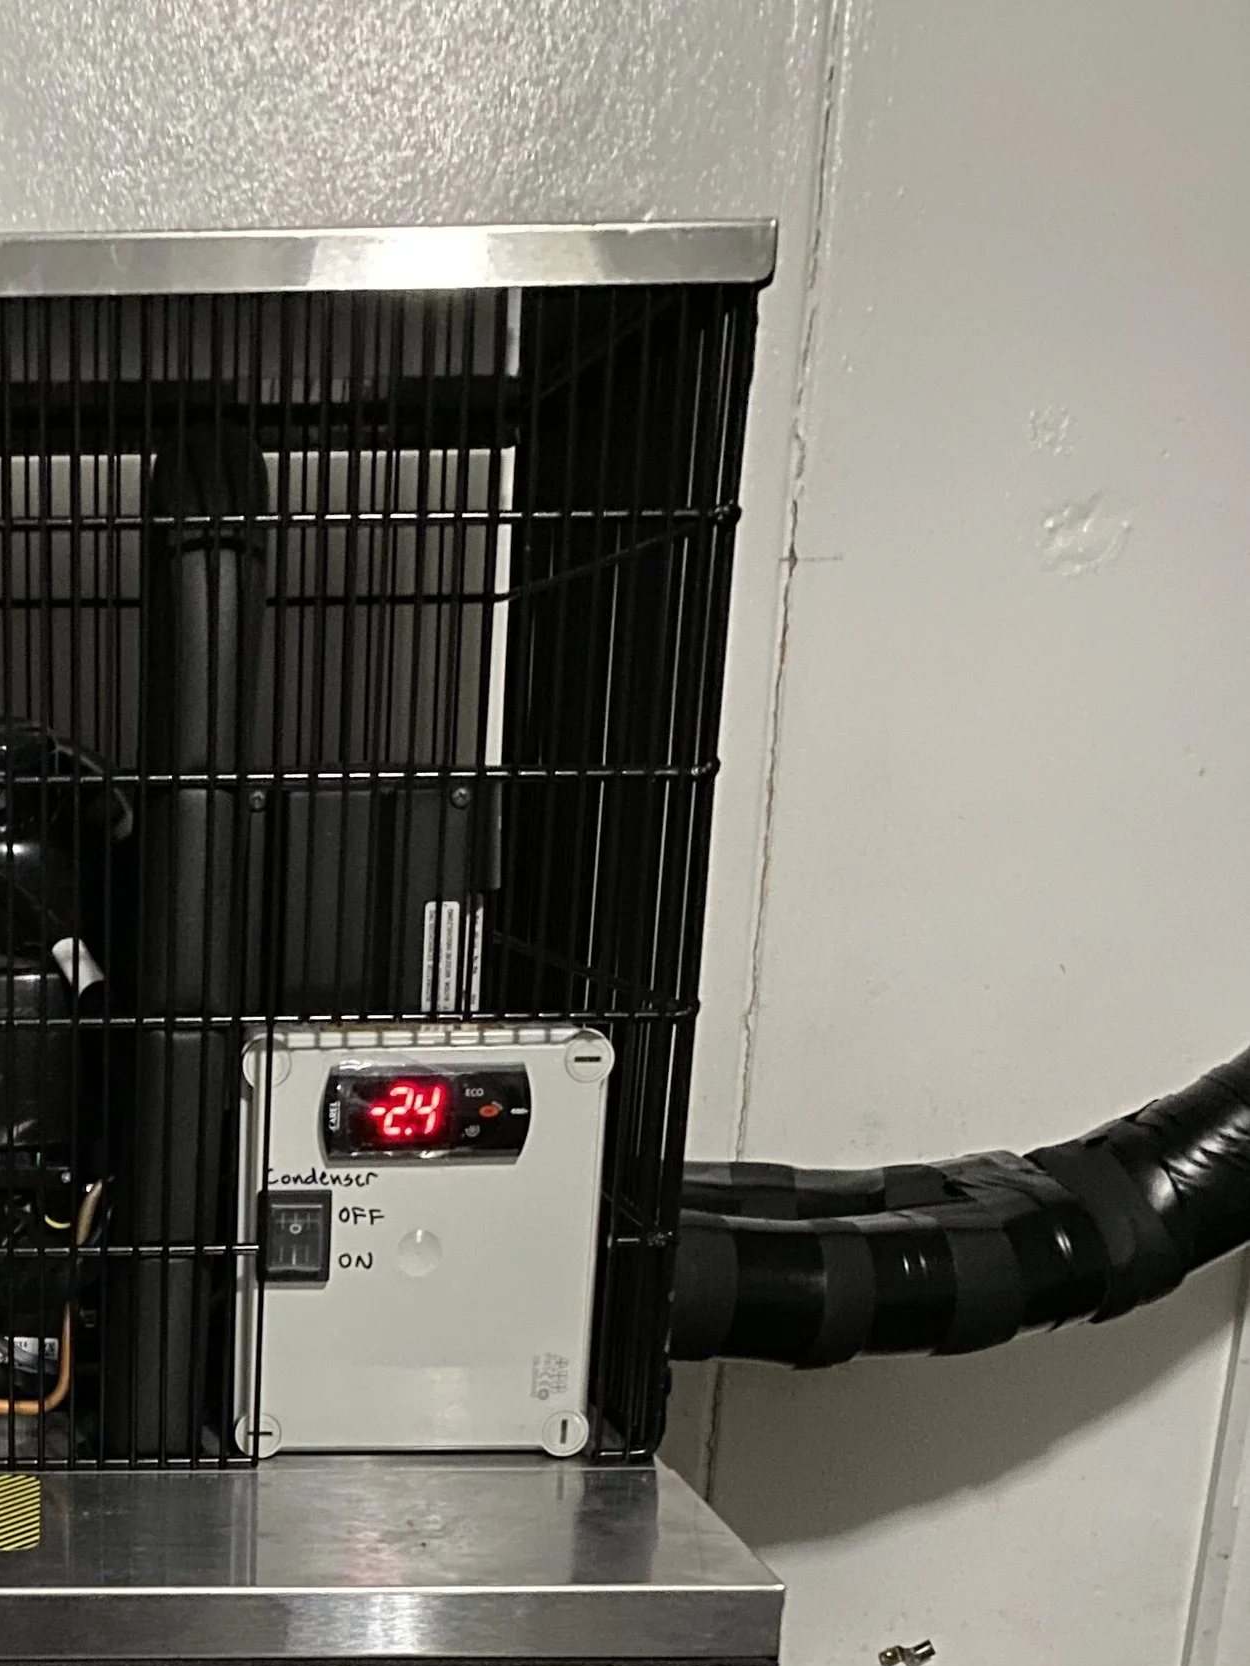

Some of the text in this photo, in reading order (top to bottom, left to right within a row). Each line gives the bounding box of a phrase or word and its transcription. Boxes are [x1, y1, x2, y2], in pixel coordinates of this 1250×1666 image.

[465, 1088, 485, 1098] ECO
[329, 1101, 340, 1131] CAREL
[338, 1207, 385, 1226] OFF
[338, 1252, 373, 1270] ON
